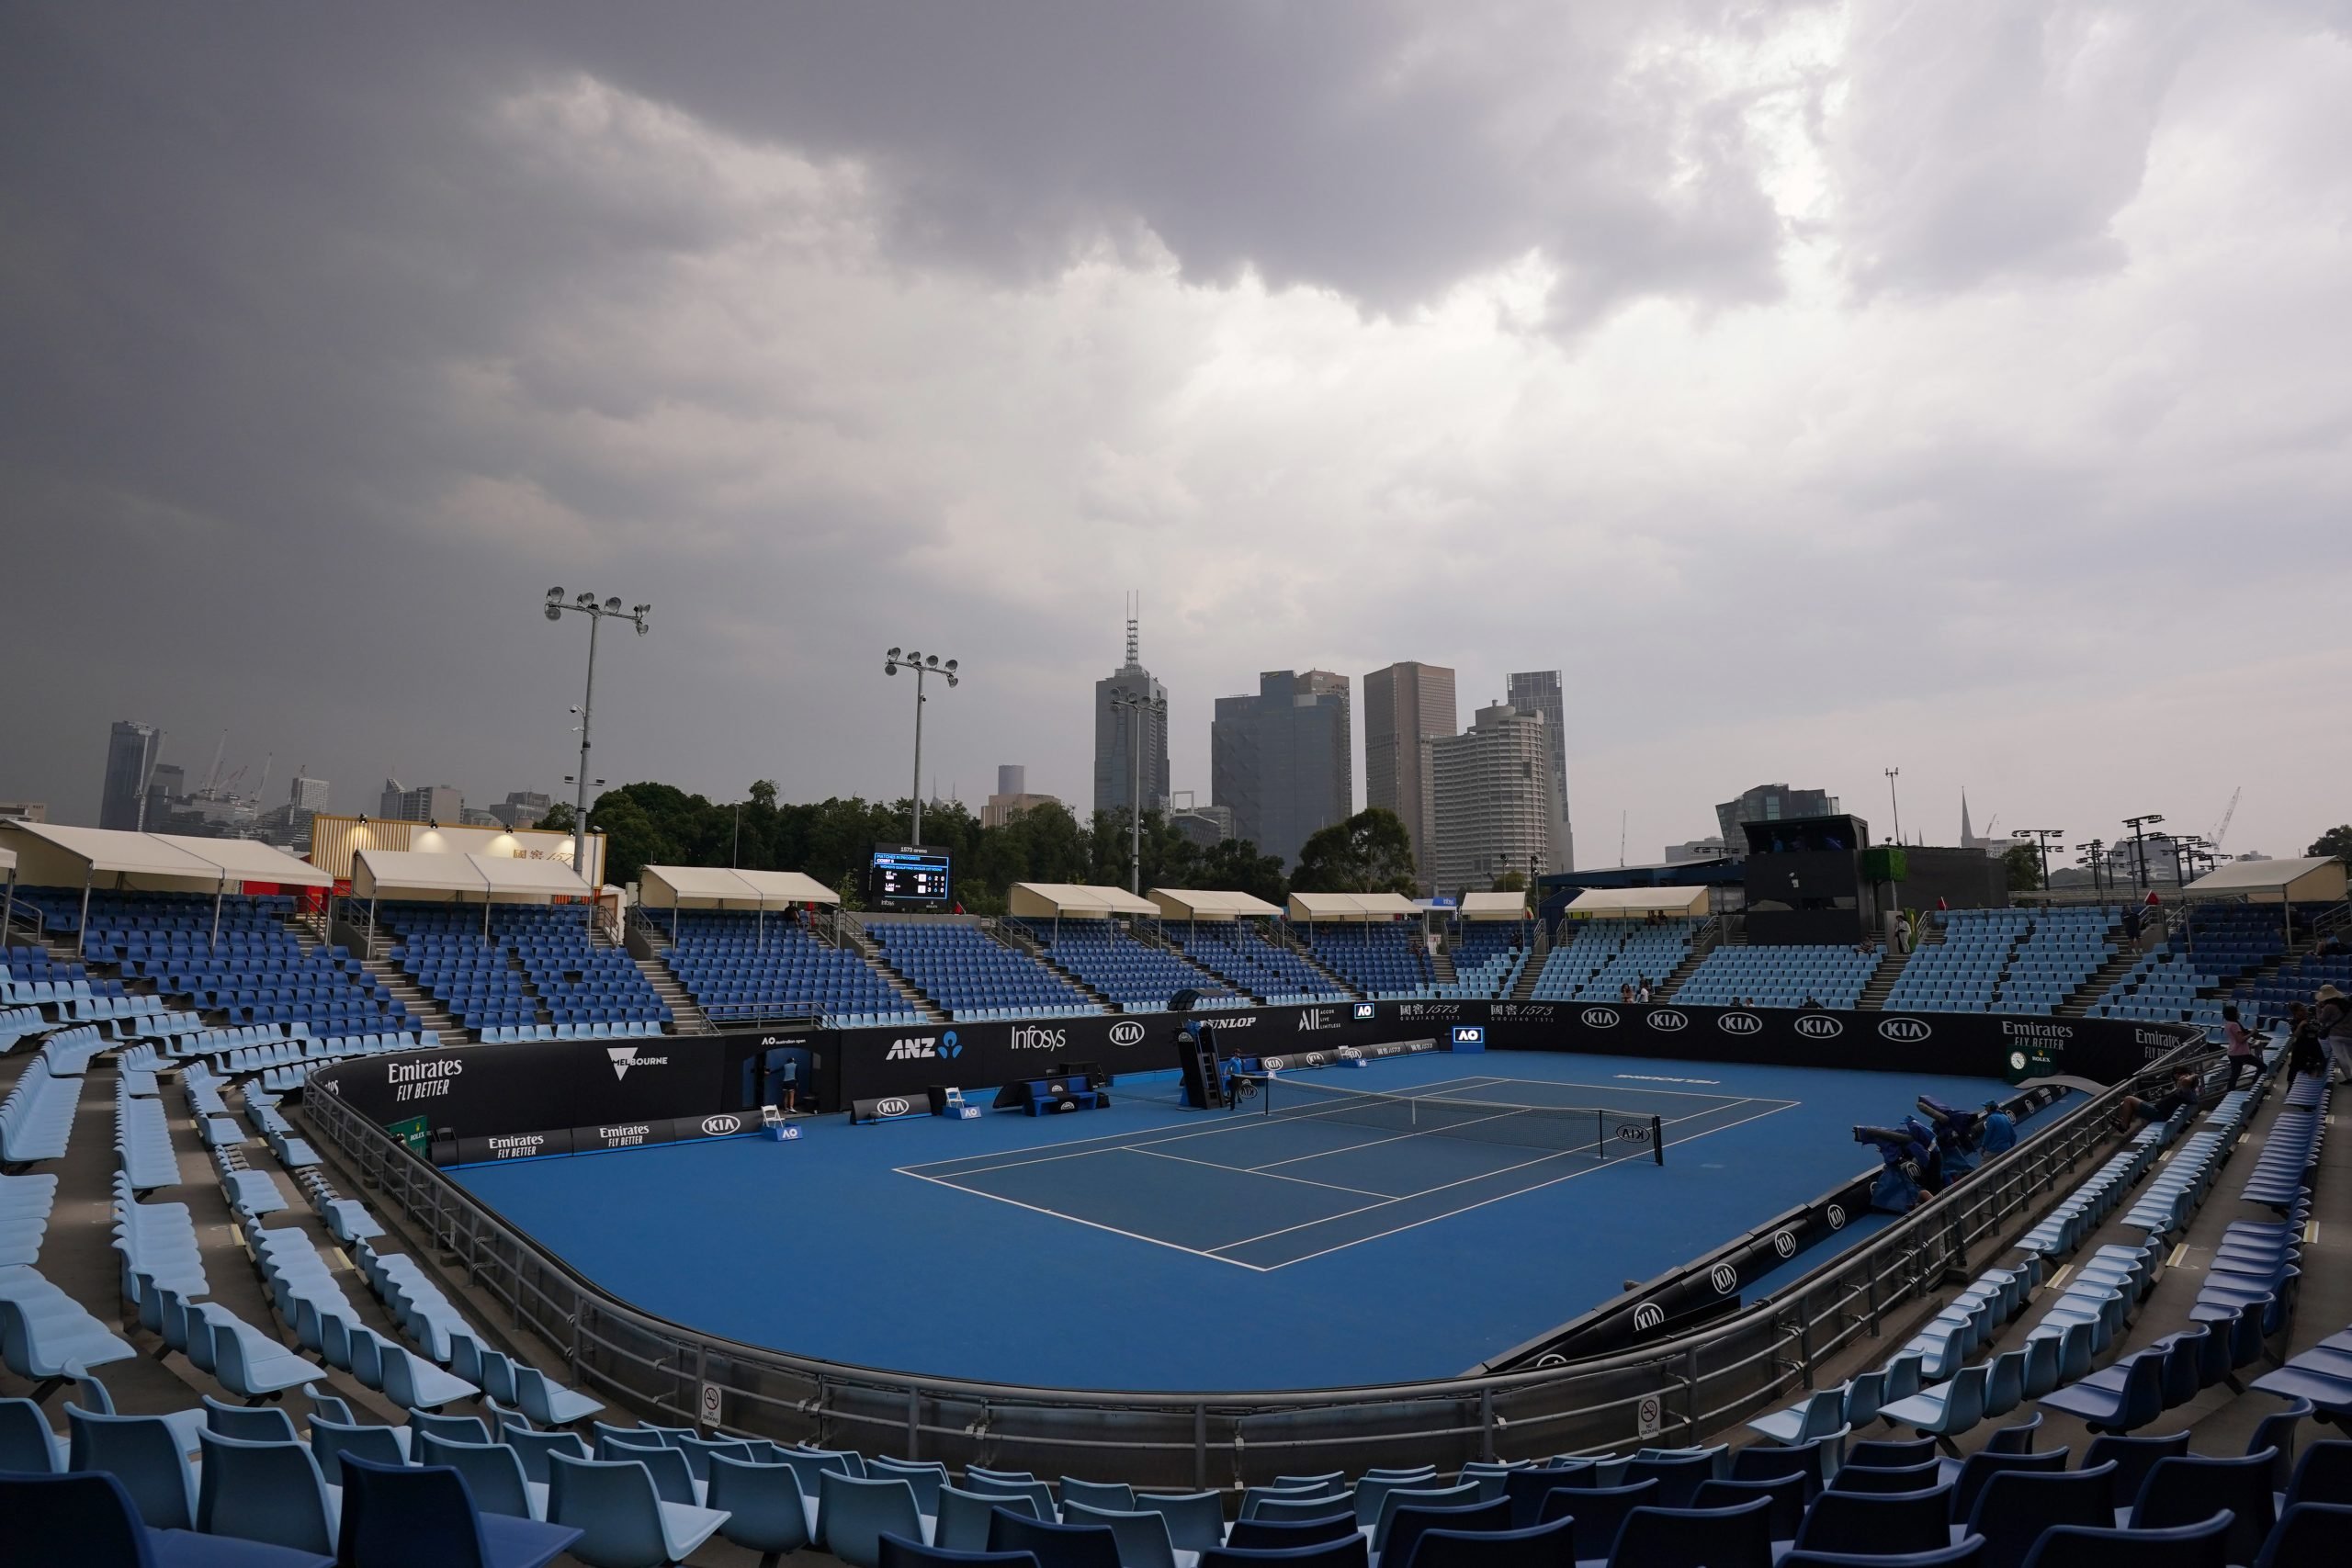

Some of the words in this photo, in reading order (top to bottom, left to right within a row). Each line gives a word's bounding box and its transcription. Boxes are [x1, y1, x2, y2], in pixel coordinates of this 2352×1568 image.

[1358, 1005, 1372, 1016] AO
[1425, 1004, 1461, 1015] 1573
[1519, 1005, 1555, 1017] 1573
[1588, 1011, 1614, 1024] KIA
[1654, 1014, 1682, 1027] KIA
[1725, 1017, 1756, 1031] KIA
[1114, 1024, 1139, 1042] KIA
[1803, 1020, 1836, 1034] KIA
[1887, 1022, 1924, 1037] KIA
[2001, 1021, 2074, 1038] Emirates
[761, 1036, 776, 1045] AO
[1012, 1025, 1066, 1052] Infosys
[1457, 1029, 1479, 1041] AO
[2134, 1028, 2180, 1048] Emirates
[885, 1037, 936, 1060] ANZ
[2144, 1046, 2156, 1059] FLY
[612, 1056, 669, 1066] MELBOURNE
[1267, 1058, 1283, 1068] KIA
[2031, 1055, 2051, 1064] ROLEX
[388, 1058, 463, 1084] Emirates
[396, 1085, 413, 1102] FLY
[413, 1078, 450, 1100] BETTER
[882, 1100, 906, 1114] KIA
[965, 1109, 977, 1118] AO
[599, 1123, 650, 1139] Emirates
[708, 1118, 735, 1132] KIA
[410, 1132, 424, 1141] ROLEX
[608, 1137, 620, 1147] FLY
[620, 1134, 643, 1146] BETTER
[781, 1129, 797, 1139] AO
[488, 1134, 544, 1150] Emirates
[497, 1147, 511, 1159] FLY
[511, 1145, 537, 1158] BETTER
[1830, 1209, 1844, 1225] KIA
[1778, 1235, 1794, 1252] KIA
[1715, 1269, 1735, 1289] KIA
[1637, 1308, 1660, 1331] KIA
[702, 1415, 718, 1423] SMOKING
